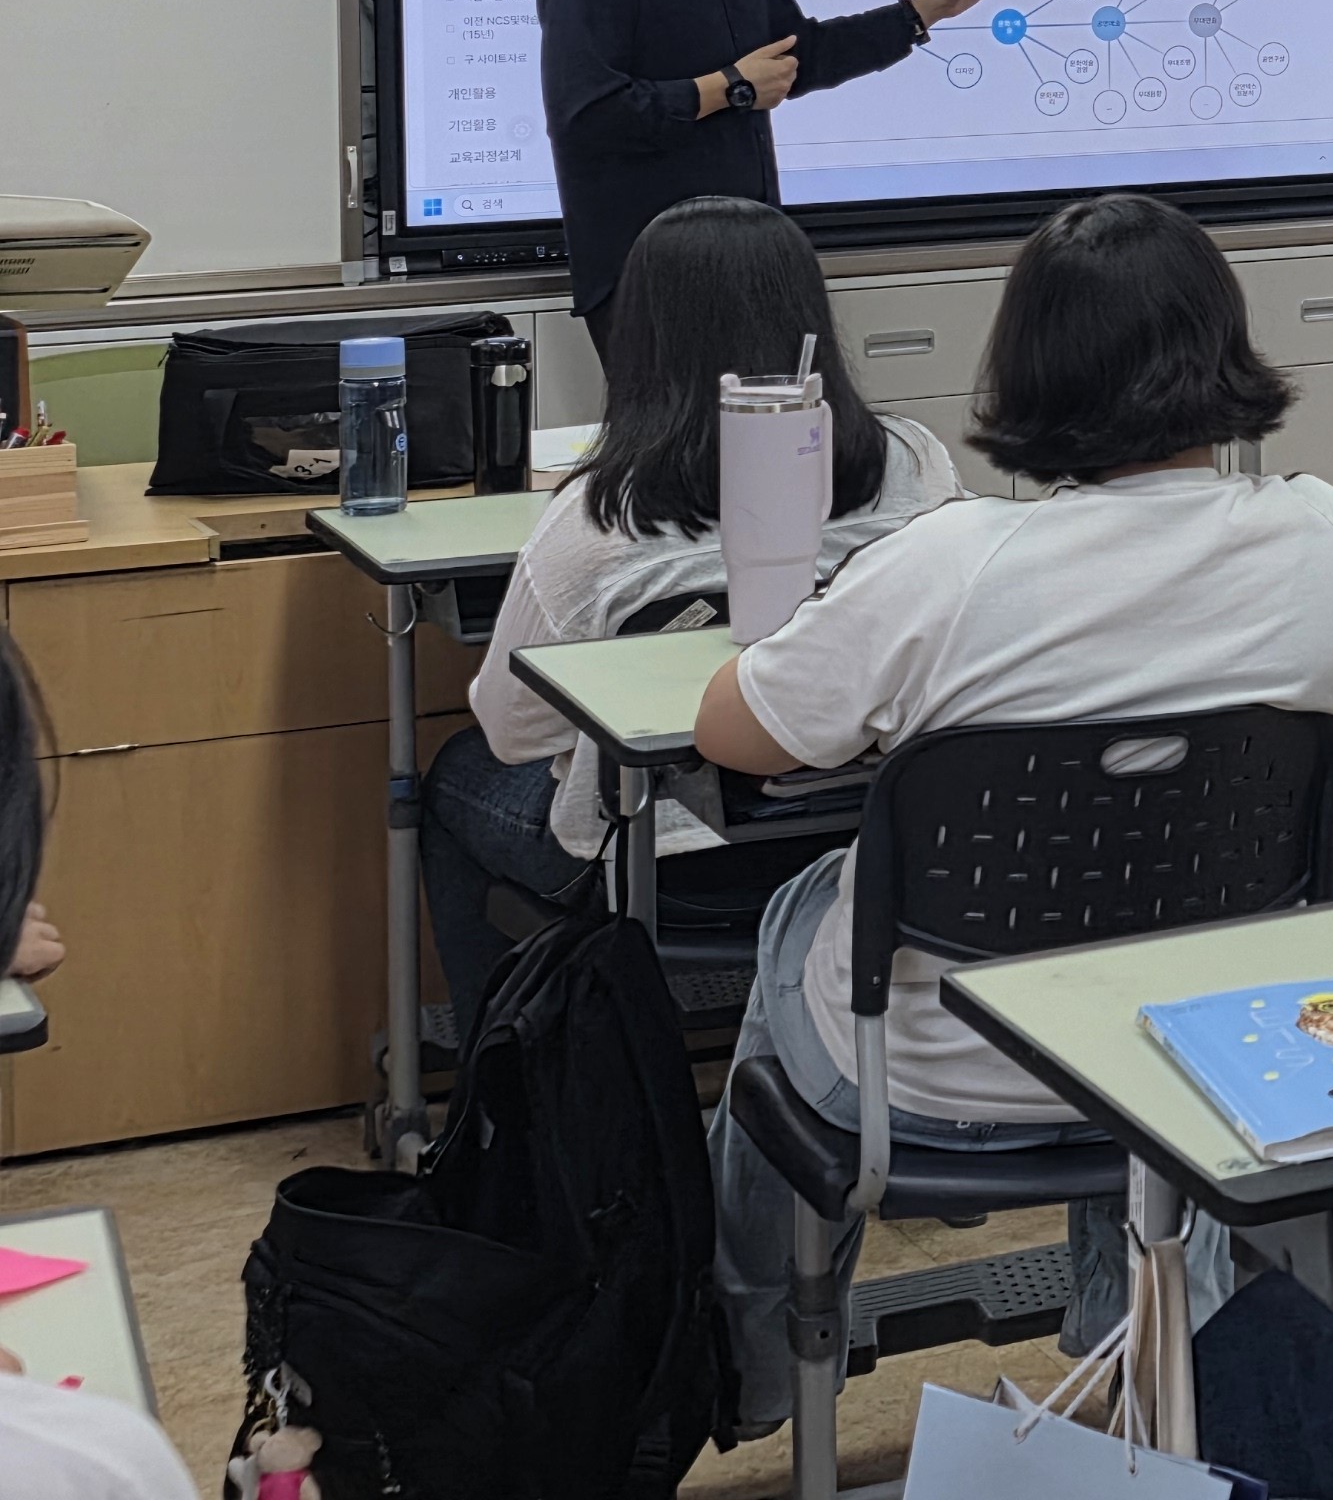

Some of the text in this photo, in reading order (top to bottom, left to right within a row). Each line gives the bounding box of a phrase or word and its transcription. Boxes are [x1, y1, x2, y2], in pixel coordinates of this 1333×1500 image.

[448, 87, 497, 100] 개인활용
[448, 118, 497, 132] 기업활용
[449, 149, 521, 163] 교육과정설계
[482, 198, 503, 209] 검색
